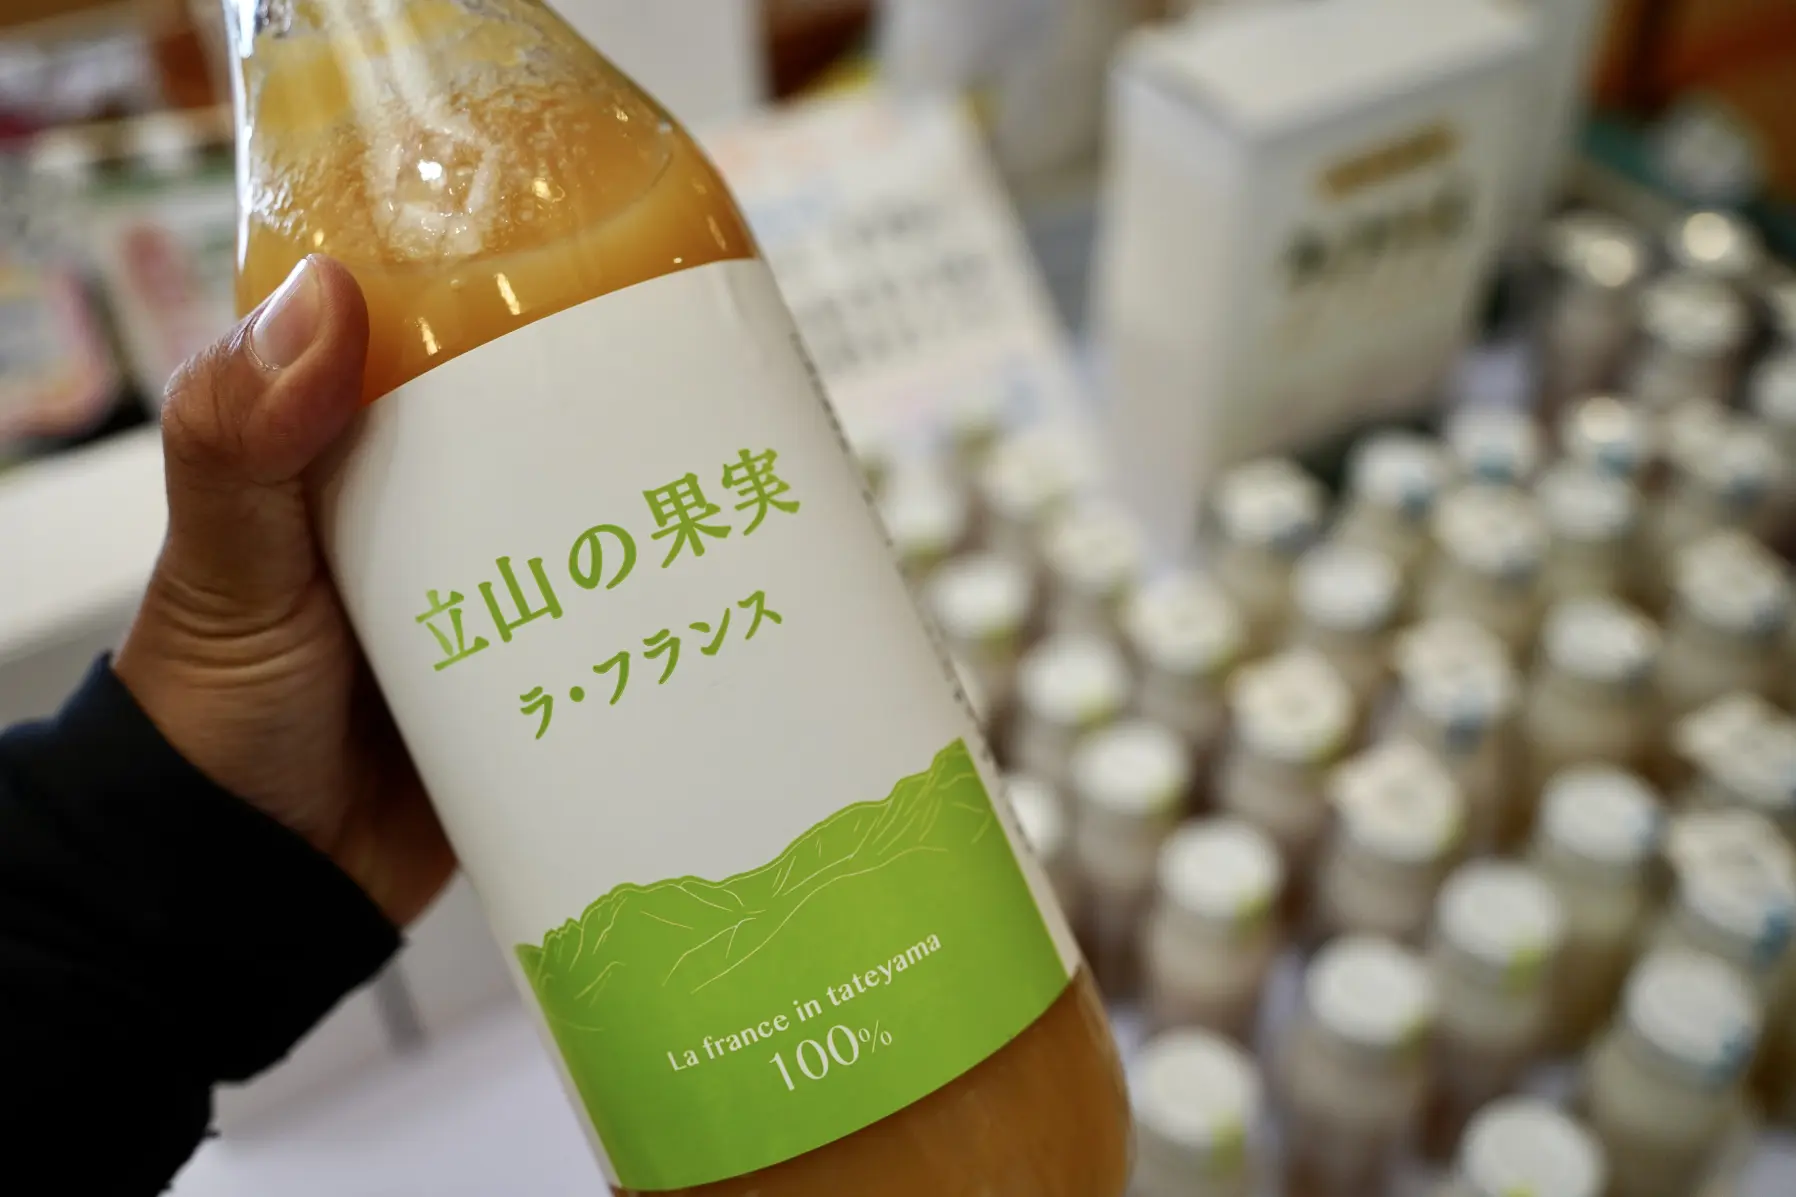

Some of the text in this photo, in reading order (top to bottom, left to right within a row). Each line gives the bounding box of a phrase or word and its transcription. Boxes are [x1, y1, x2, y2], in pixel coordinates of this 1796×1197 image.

[415, 448, 801, 671] 立山の果実
[519, 590, 783, 740] ラ・フランス
[667, 933, 942, 1071] La france in tateyama
[768, 1019, 893, 1092] 100%
